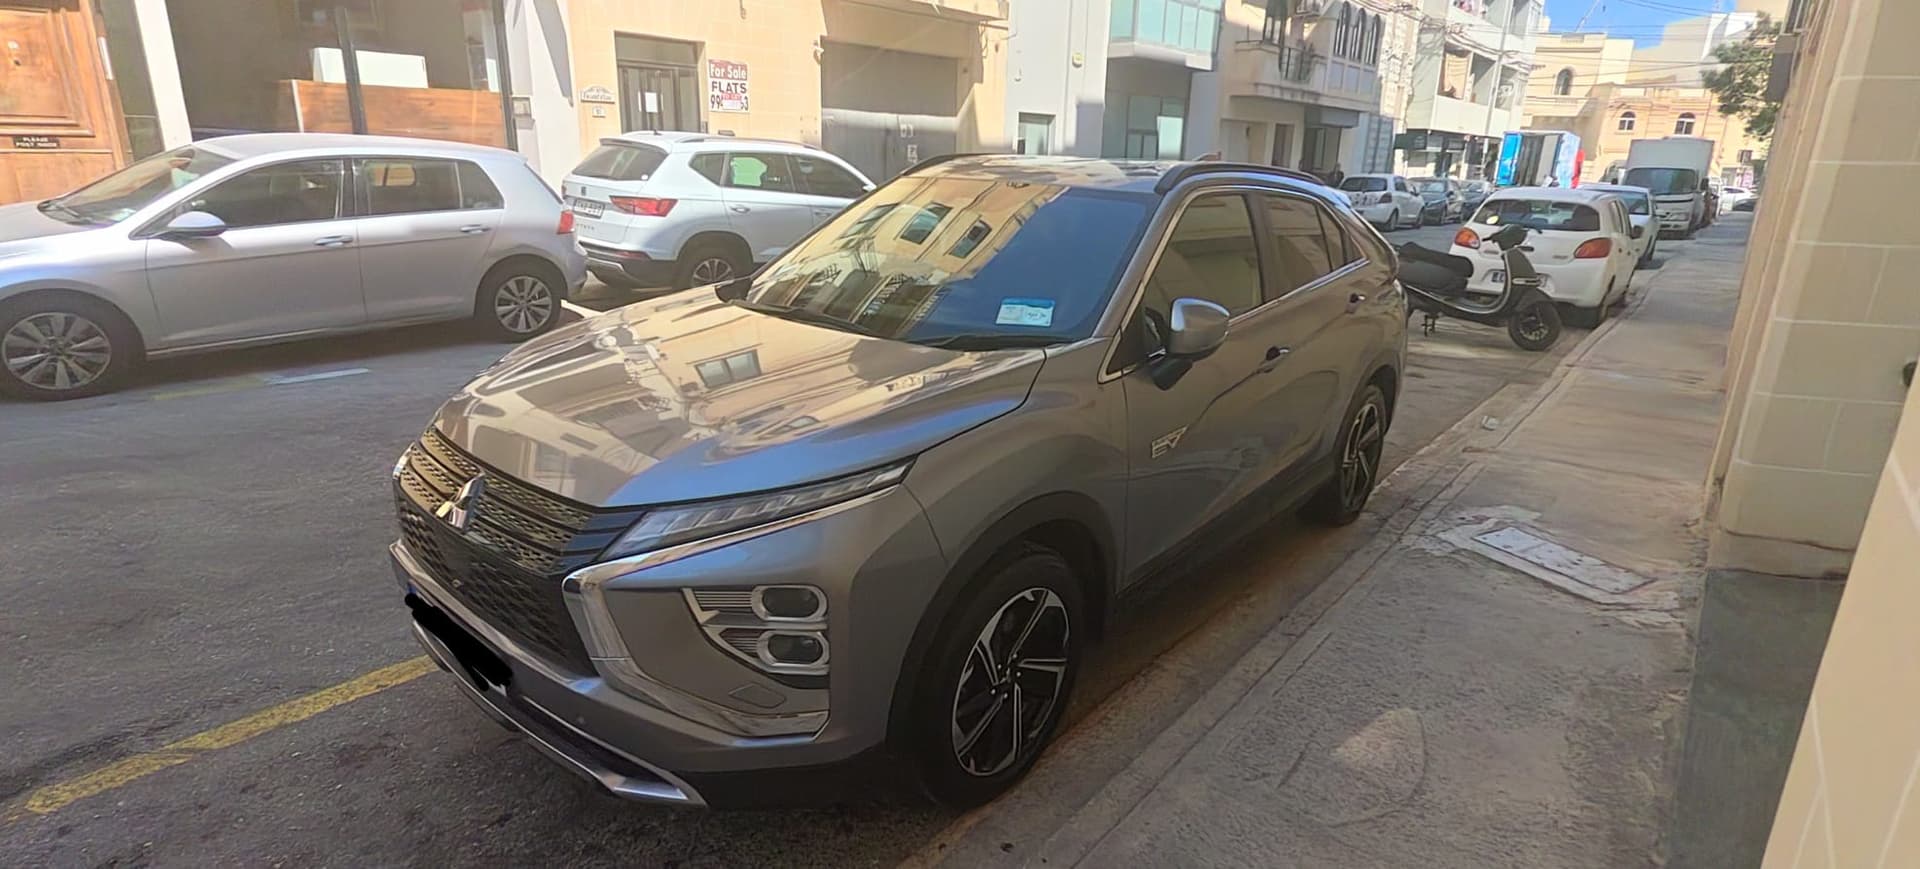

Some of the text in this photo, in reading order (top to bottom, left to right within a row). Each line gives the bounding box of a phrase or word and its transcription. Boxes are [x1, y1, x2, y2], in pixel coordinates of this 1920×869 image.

[711, 63, 747, 79] For Sale
[711, 81, 747, 94] FLATS
